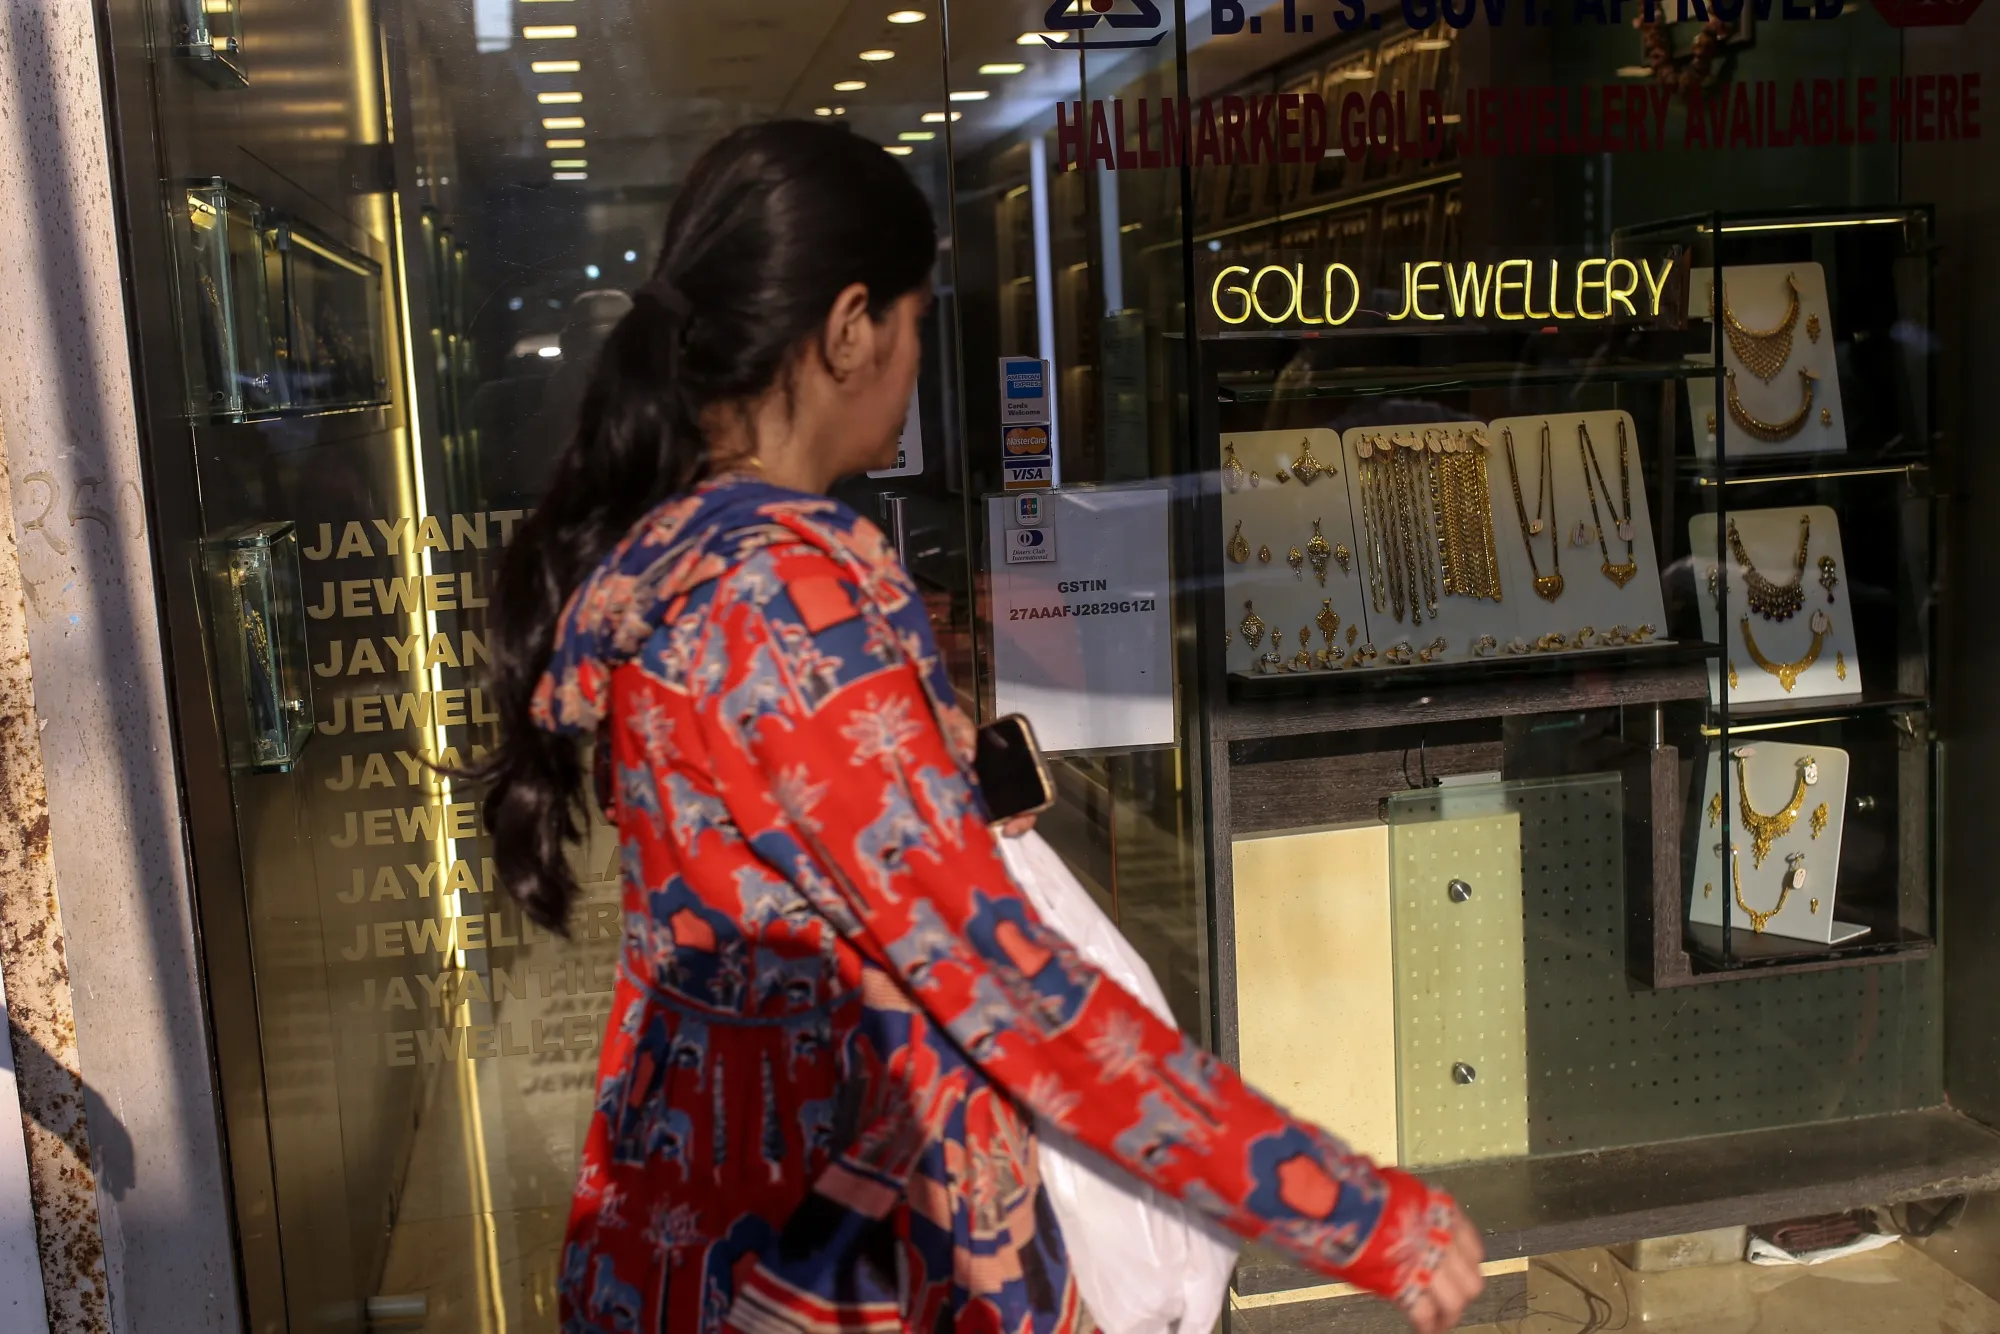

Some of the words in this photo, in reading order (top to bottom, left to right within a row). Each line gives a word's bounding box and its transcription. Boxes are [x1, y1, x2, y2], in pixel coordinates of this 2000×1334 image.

[1057, 93, 1327, 173] HALLMARKED
[1340, 89, 1444, 164] GOLD
[1458, 83, 1671, 157] JEWELLERY
[1684, 77, 1876, 150] AVAILABLE
[1890, 73, 1981, 142] HERE
[1212, 263, 1359, 325] GOLD
[1387, 258, 1674, 320] JEWELLERY
[1007, 373, 1040, 381] AMERICAN
[1007, 436, 1047, 446] MasterCard
[1012, 468, 1043, 480] VISA
[1057, 579, 1107, 593] GSTIN
